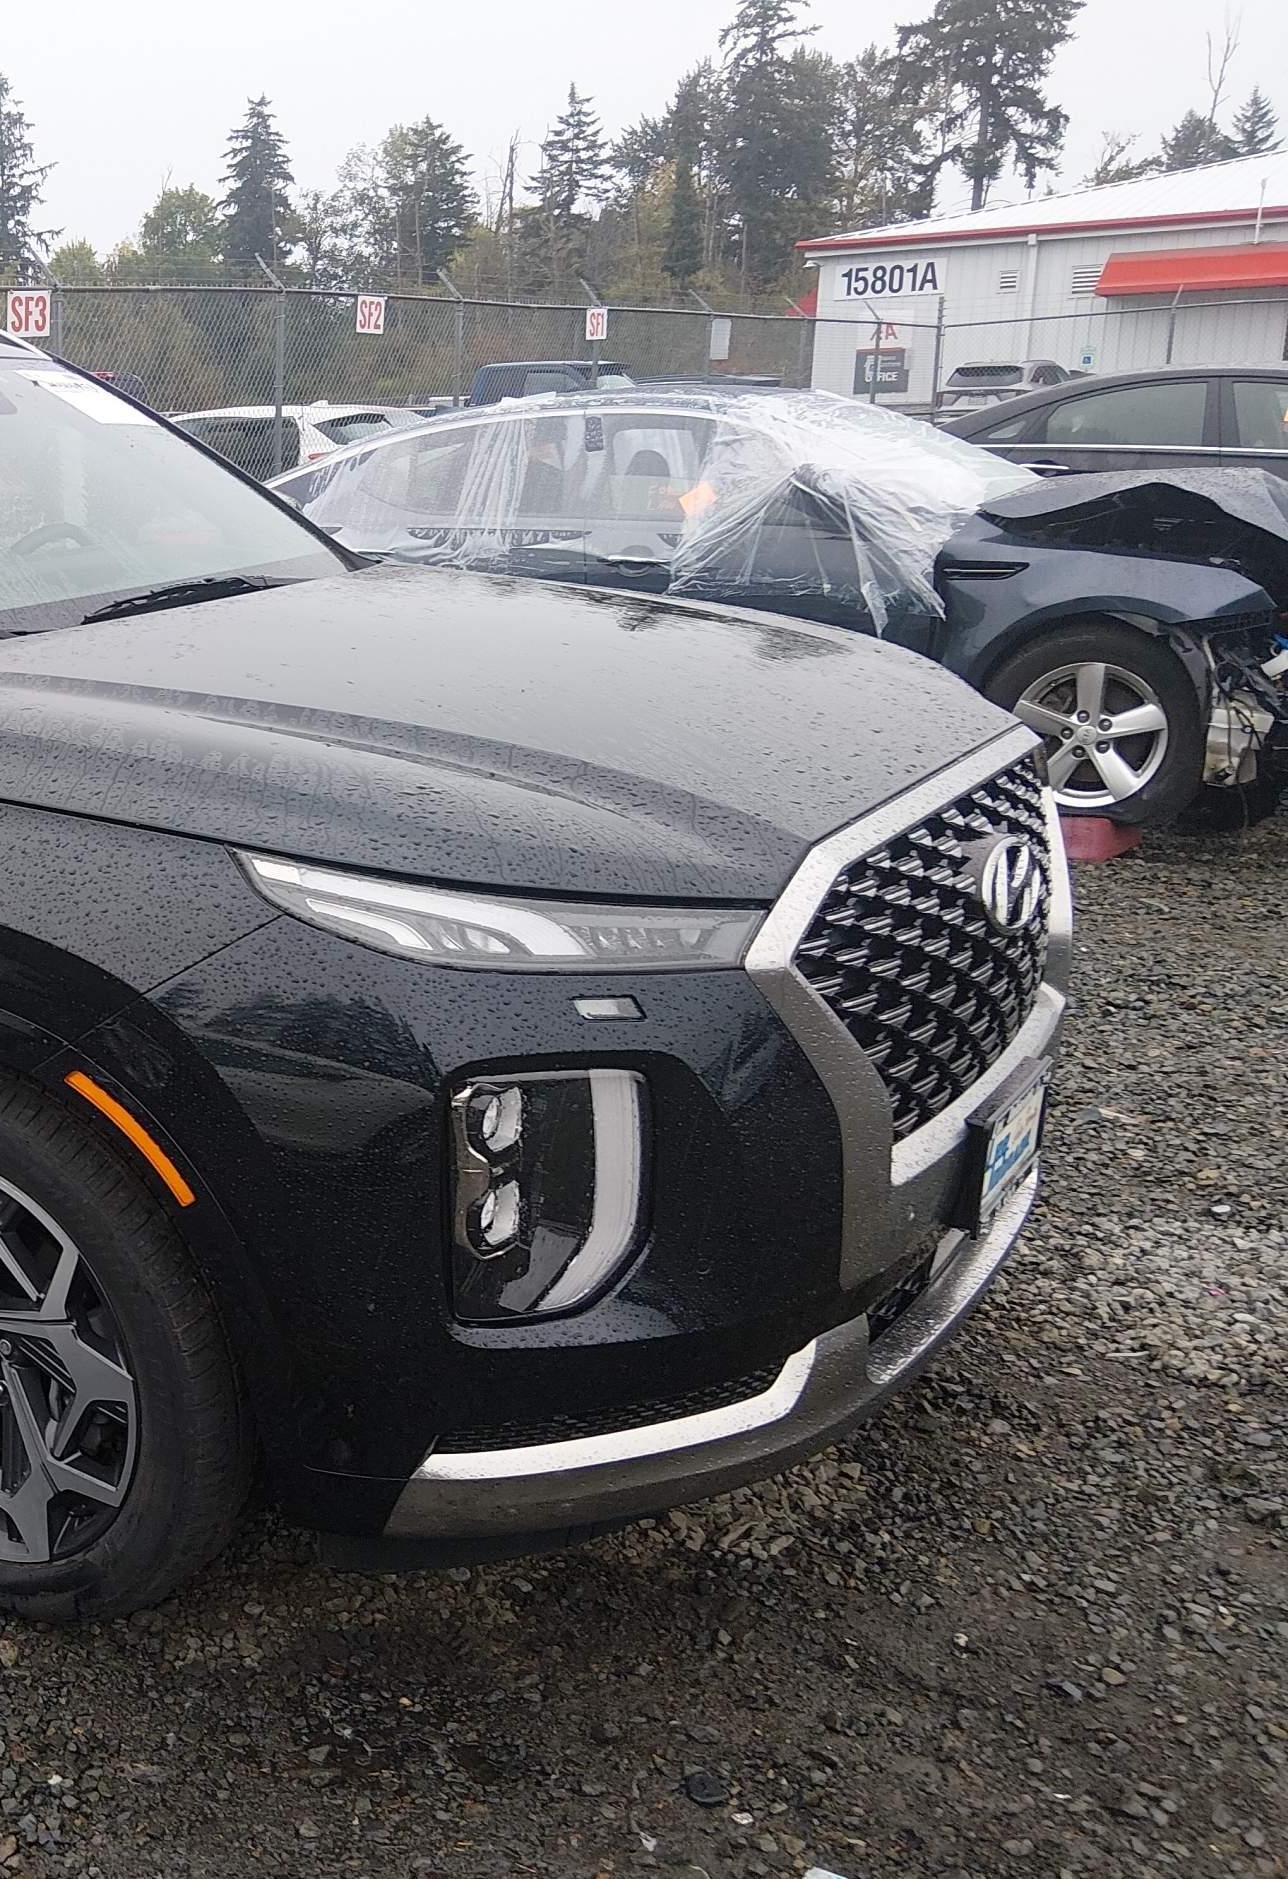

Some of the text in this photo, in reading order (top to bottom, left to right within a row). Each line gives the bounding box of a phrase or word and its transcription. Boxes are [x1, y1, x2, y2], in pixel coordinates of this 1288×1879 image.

[841, 261, 939, 296] 15801A
[10, 295, 47, 333] SF3
[359, 299, 383, 330] SF2
[589, 311, 605, 337] SF1
[864, 371, 899, 383] OFICE
